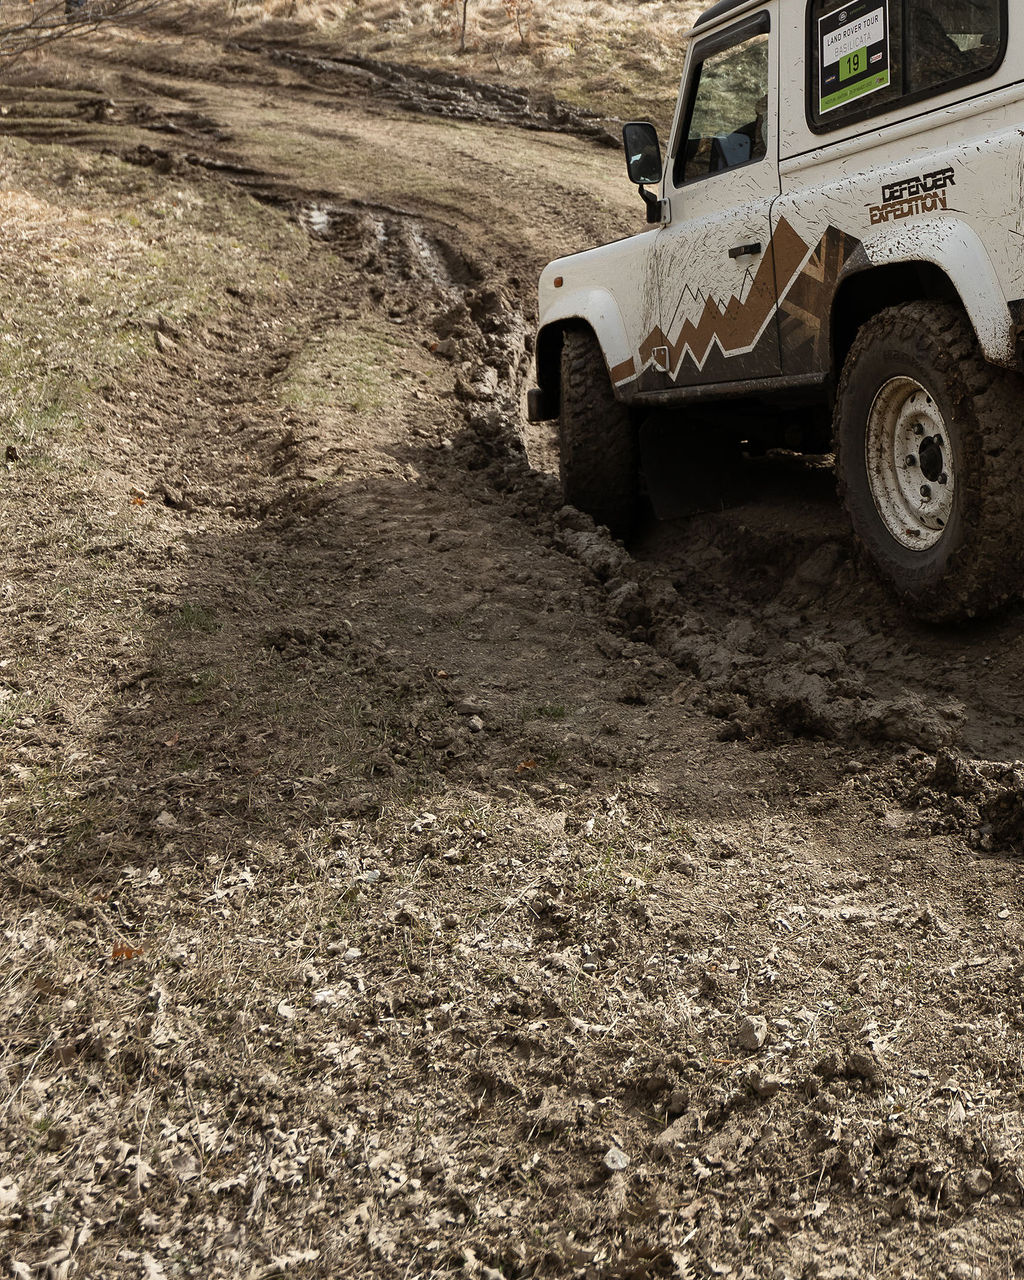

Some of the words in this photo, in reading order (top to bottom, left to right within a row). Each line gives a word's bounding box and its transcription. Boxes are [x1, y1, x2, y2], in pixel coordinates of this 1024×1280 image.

[827, 33, 842, 47] LAND
[843, 23, 862, 38] ROVER
[863, 14, 879, 28] TOUR
[834, 32, 872, 57] BASILICATA
[846, 54, 859, 74] 19
[881, 166, 956, 203] DEFENDER
[869, 188, 947, 225] EXPEDITION
